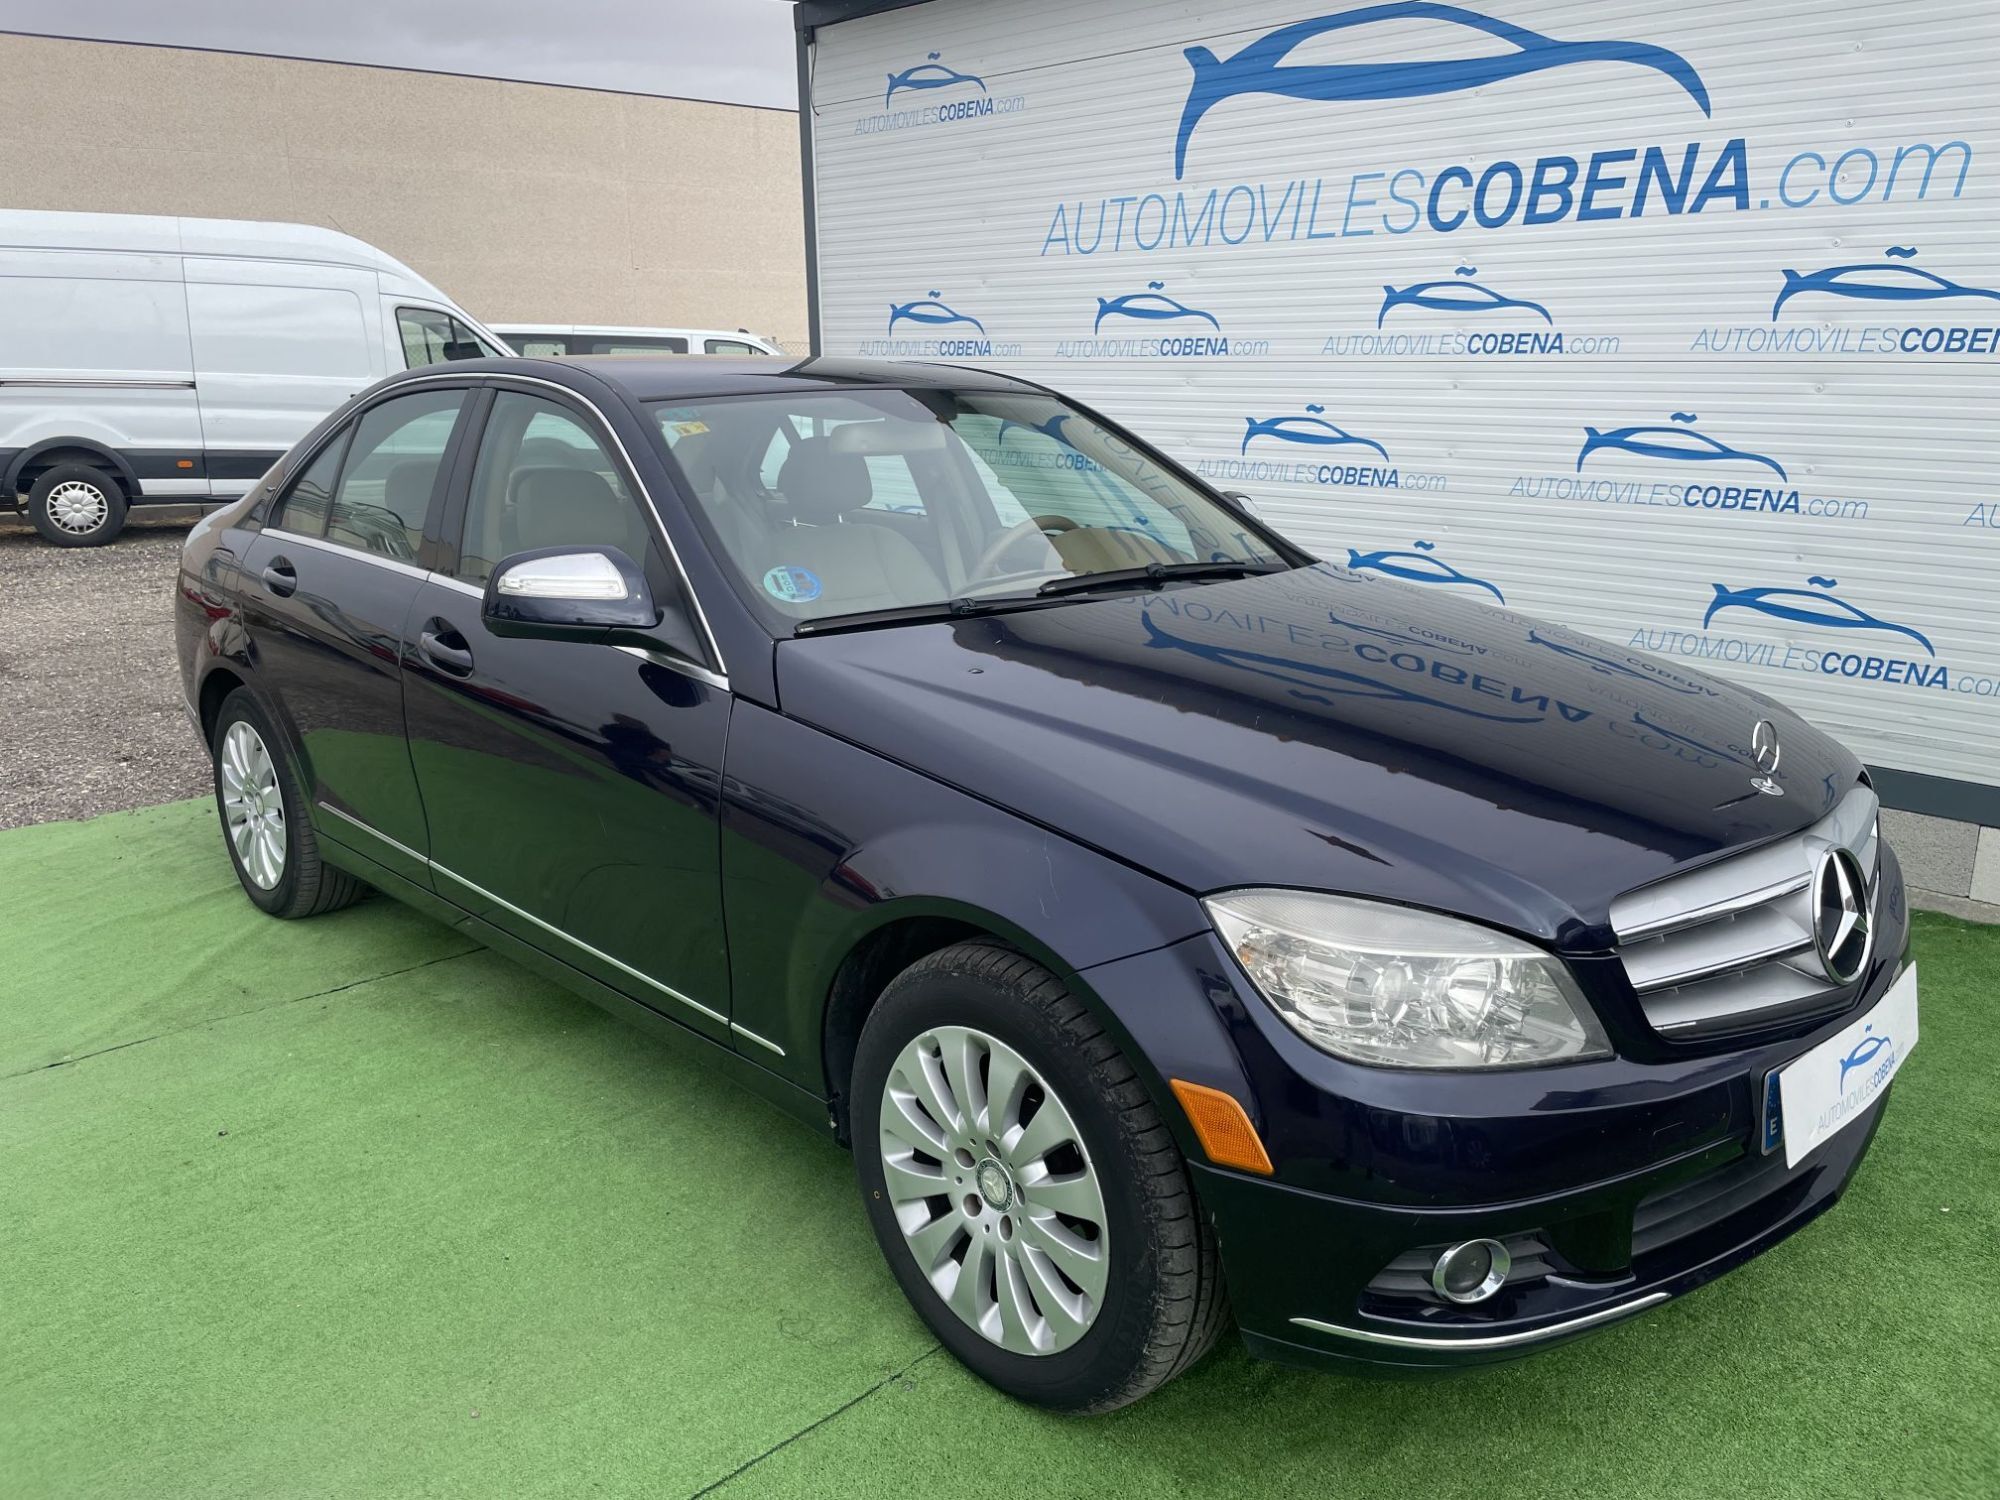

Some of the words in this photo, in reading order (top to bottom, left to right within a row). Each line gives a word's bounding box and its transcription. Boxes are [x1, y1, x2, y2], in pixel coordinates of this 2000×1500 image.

[854, 95, 1025, 136] AUTOMOVILESCOBENA.com
[1041, 138, 1973, 256] AUTOMOVILESCOBENA.com
[858, 338, 1022, 358] AUTOMOVILESCOBENA.com
[1055, 337, 1269, 359] AUTOMOVILESCOBENA.com
[1321, 332, 1620, 355] AUTOMOVILESCOBENA.com
[1197, 460, 1447, 491] AUTOMOVILESCOBENA.com
[1510, 476, 1869, 519] AUTOMOVILESCOBENA.com
